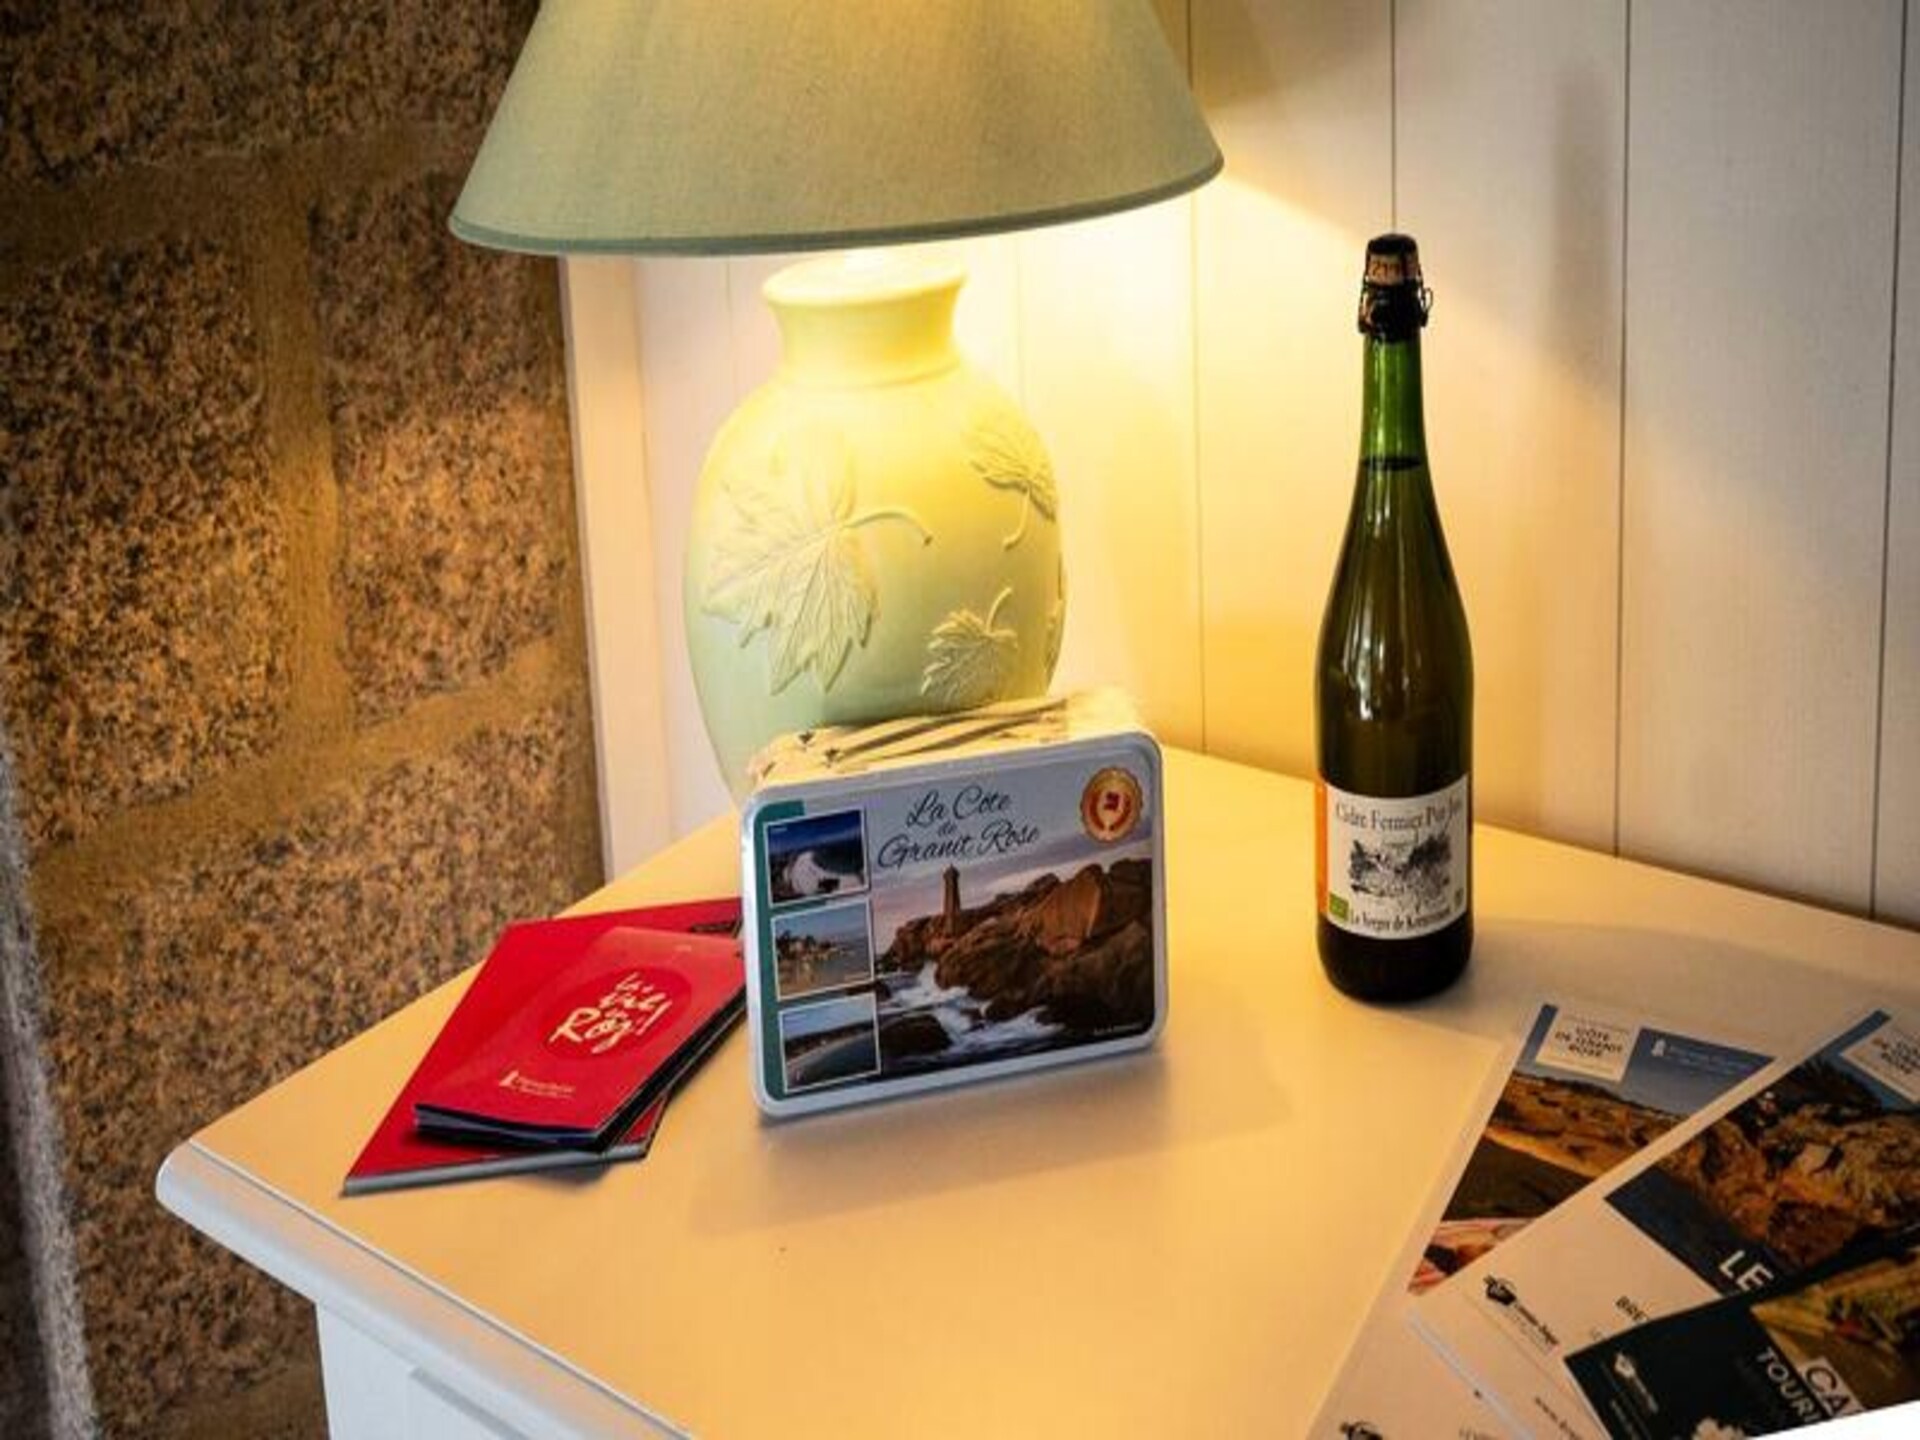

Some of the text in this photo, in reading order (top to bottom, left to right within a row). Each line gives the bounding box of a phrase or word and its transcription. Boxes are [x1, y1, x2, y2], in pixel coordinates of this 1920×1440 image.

[906, 788, 945, 828] La
[878, 818, 1041, 870] Granit Rose
[937, 820, 957, 837] de
[1719, 1250, 1774, 1291] LE
